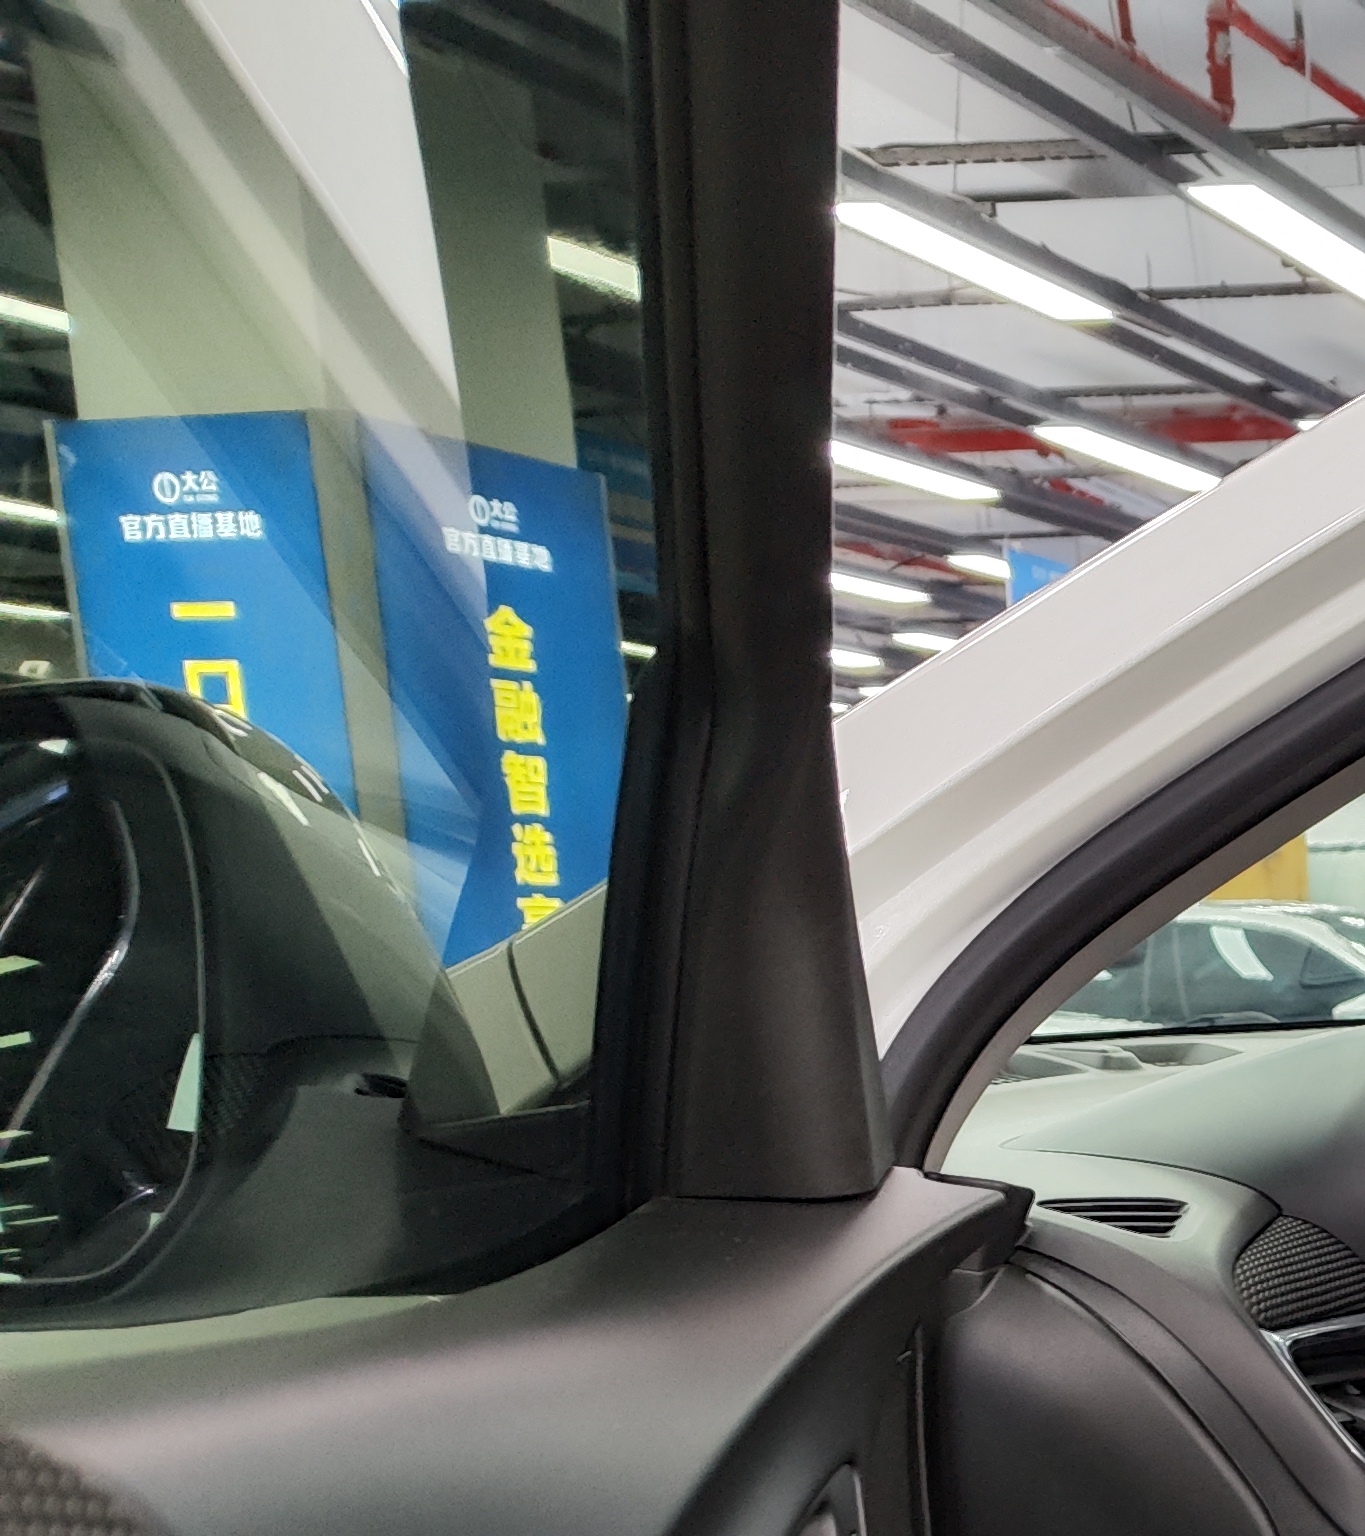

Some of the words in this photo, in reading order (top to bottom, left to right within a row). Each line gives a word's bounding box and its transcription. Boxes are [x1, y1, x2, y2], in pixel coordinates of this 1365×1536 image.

[180, 470, 219, 491] 大公
[119, 510, 264, 543] 官方直播基地
